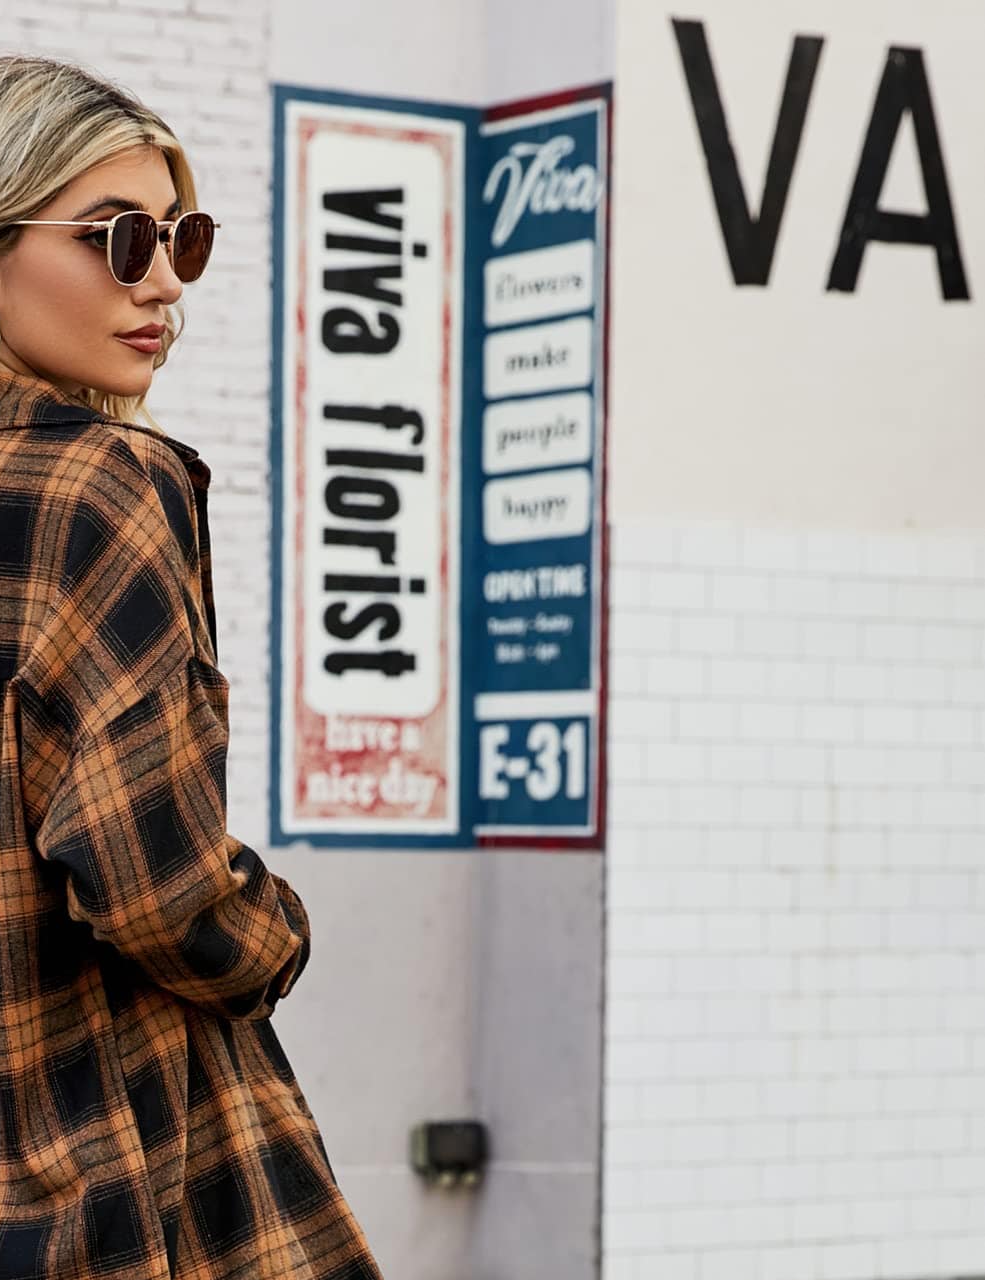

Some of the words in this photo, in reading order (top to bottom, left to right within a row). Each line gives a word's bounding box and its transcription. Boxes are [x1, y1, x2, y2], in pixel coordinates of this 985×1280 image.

[483, 135, 604, 248] Viva
[670, 17, 973, 304] VA
[321, 187, 428, 355] viva
[321, 403, 426, 678] florist
[479, 721, 586, 800] E-31
